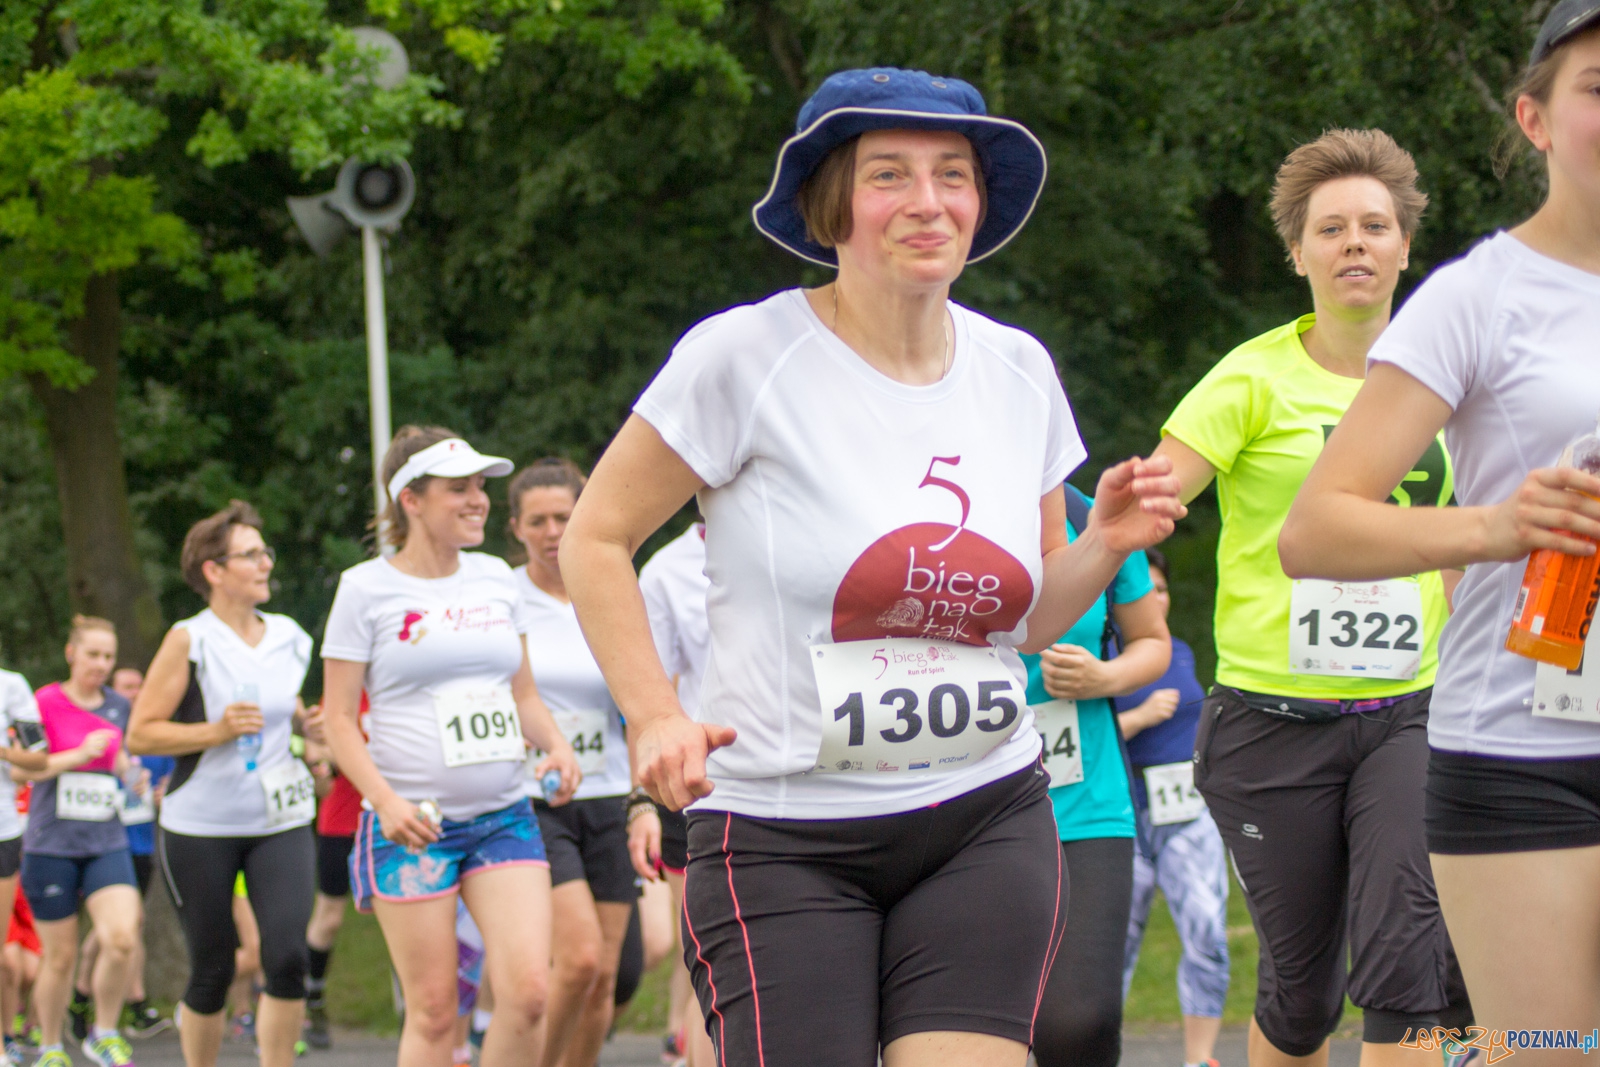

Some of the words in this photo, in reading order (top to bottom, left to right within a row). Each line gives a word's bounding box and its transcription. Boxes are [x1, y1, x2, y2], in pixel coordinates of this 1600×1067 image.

[918, 455, 971, 552] 5
[903, 546, 1002, 616] bieg
[929, 598, 966, 618] na
[922, 618, 970, 639] tak
[1298, 609, 1419, 651] 1322
[871, 648, 888, 680] 5
[892, 648, 928, 668] bieg
[928, 666, 945, 675] Spirit
[446, 710, 518, 742] 1091
[833, 680, 1018, 747] 1305
[64, 789, 115, 808] 1002
